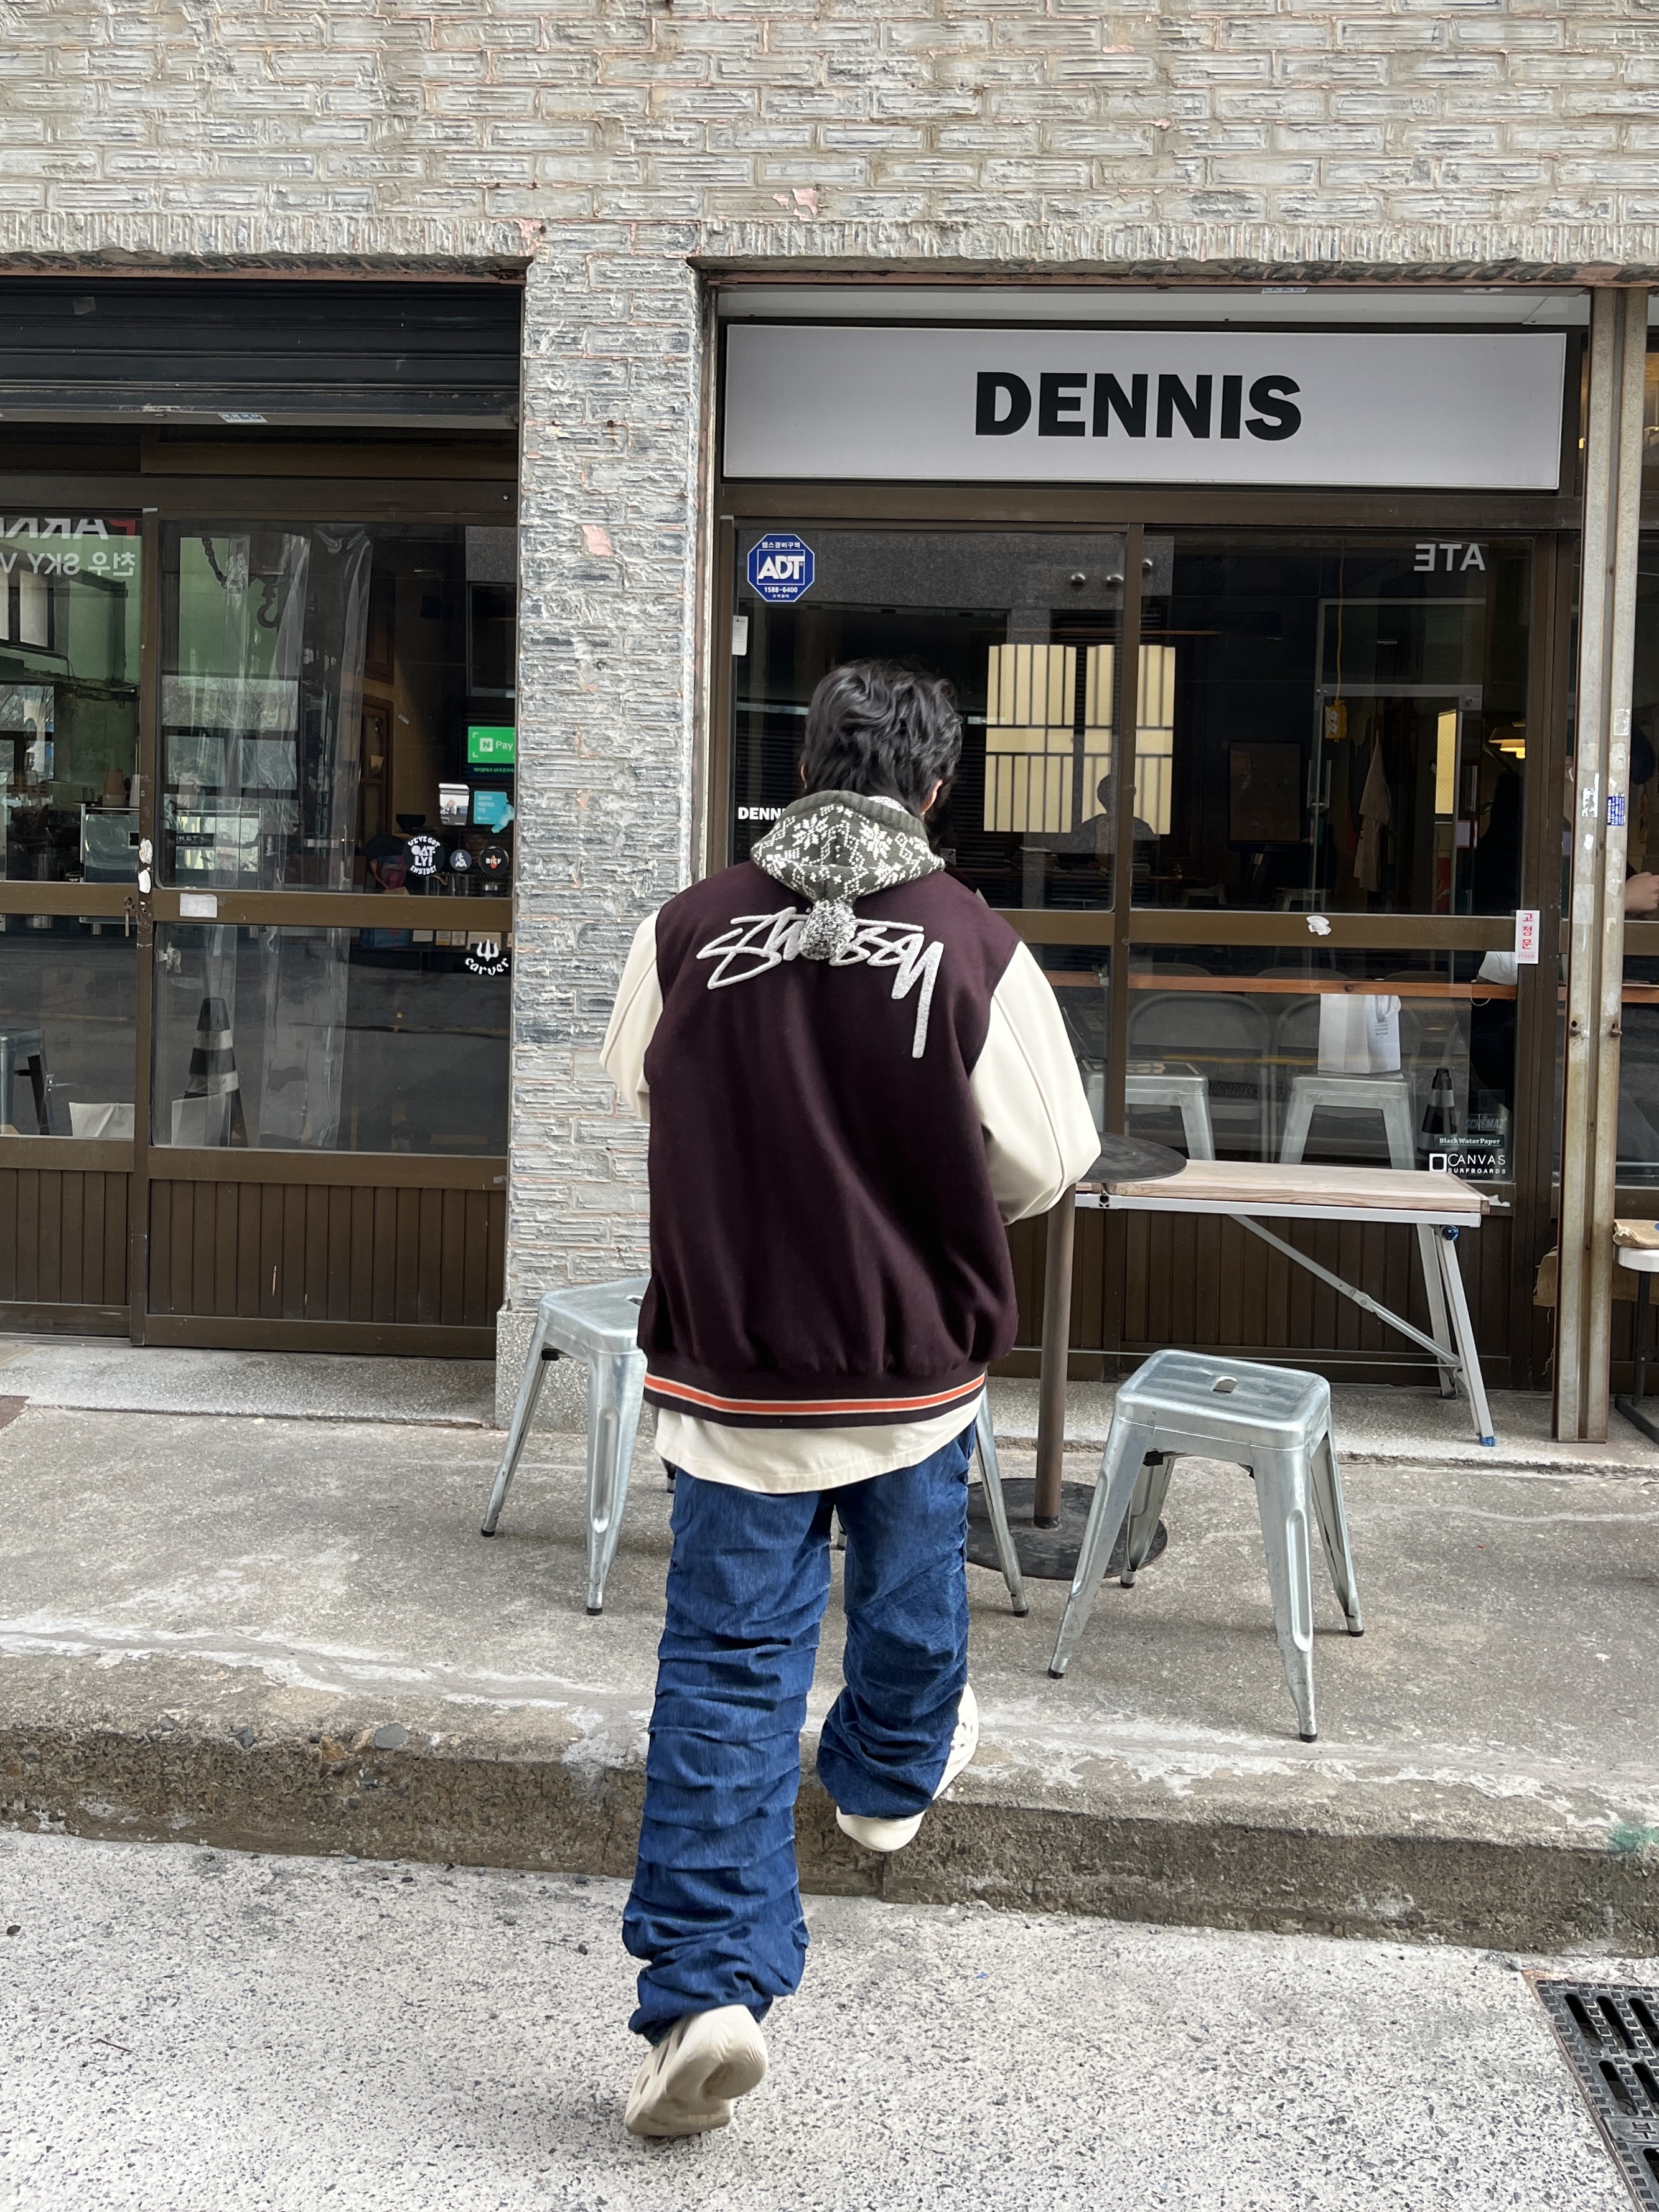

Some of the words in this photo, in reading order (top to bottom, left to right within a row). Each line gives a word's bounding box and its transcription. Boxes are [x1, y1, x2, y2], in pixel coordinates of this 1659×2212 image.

[975, 372, 1301, 441] DENNIS
[757, 556, 804, 580] ADT
[496, 740, 513, 752] Pay
[738, 806, 786, 820] DENN
[428, 837, 441, 847] GOT
[1522, 913, 1533, 950] 고정문
[465, 958, 509, 976] carver
[1448, 1154, 1506, 1167] CANVAS
